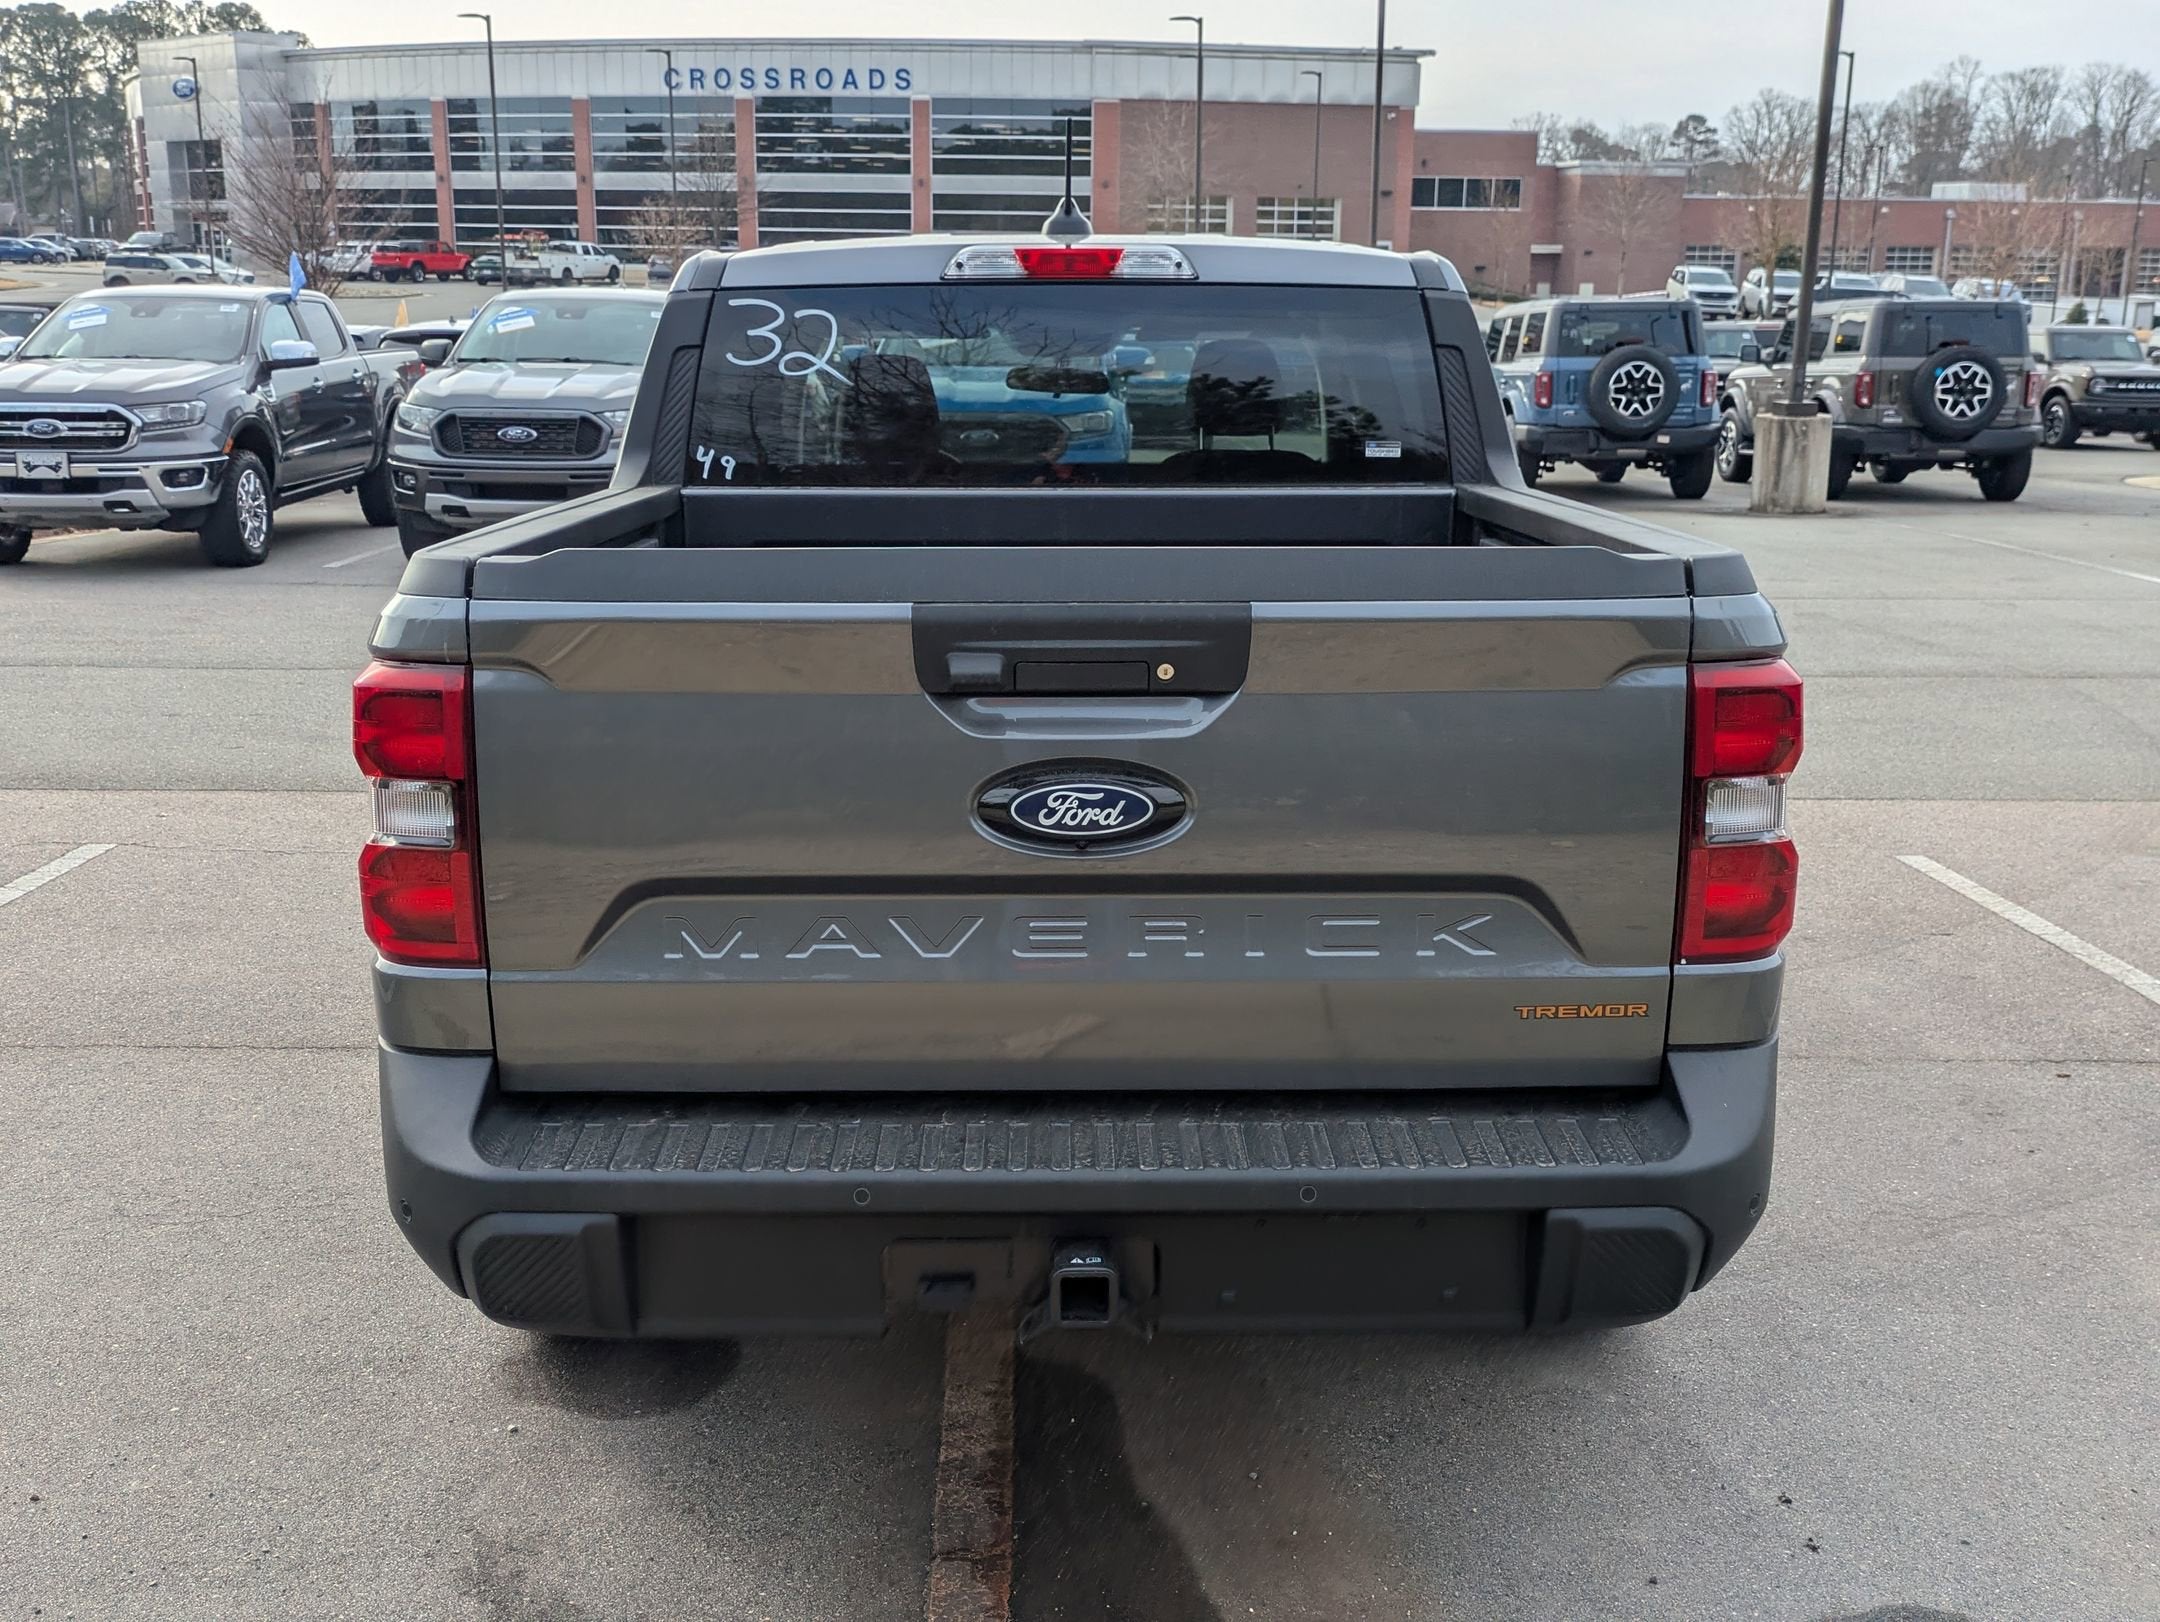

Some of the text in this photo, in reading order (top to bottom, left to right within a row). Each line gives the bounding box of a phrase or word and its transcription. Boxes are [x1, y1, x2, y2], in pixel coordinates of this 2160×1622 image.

[664, 68, 912, 91] CROSSROADS
[726, 298, 855, 386] 32
[696, 445, 737, 480] 49
[1038, 791, 1126, 826] Ford
[664, 914, 1497, 958] MAVERICK
[1514, 1003, 1649, 1019] TREMOR
